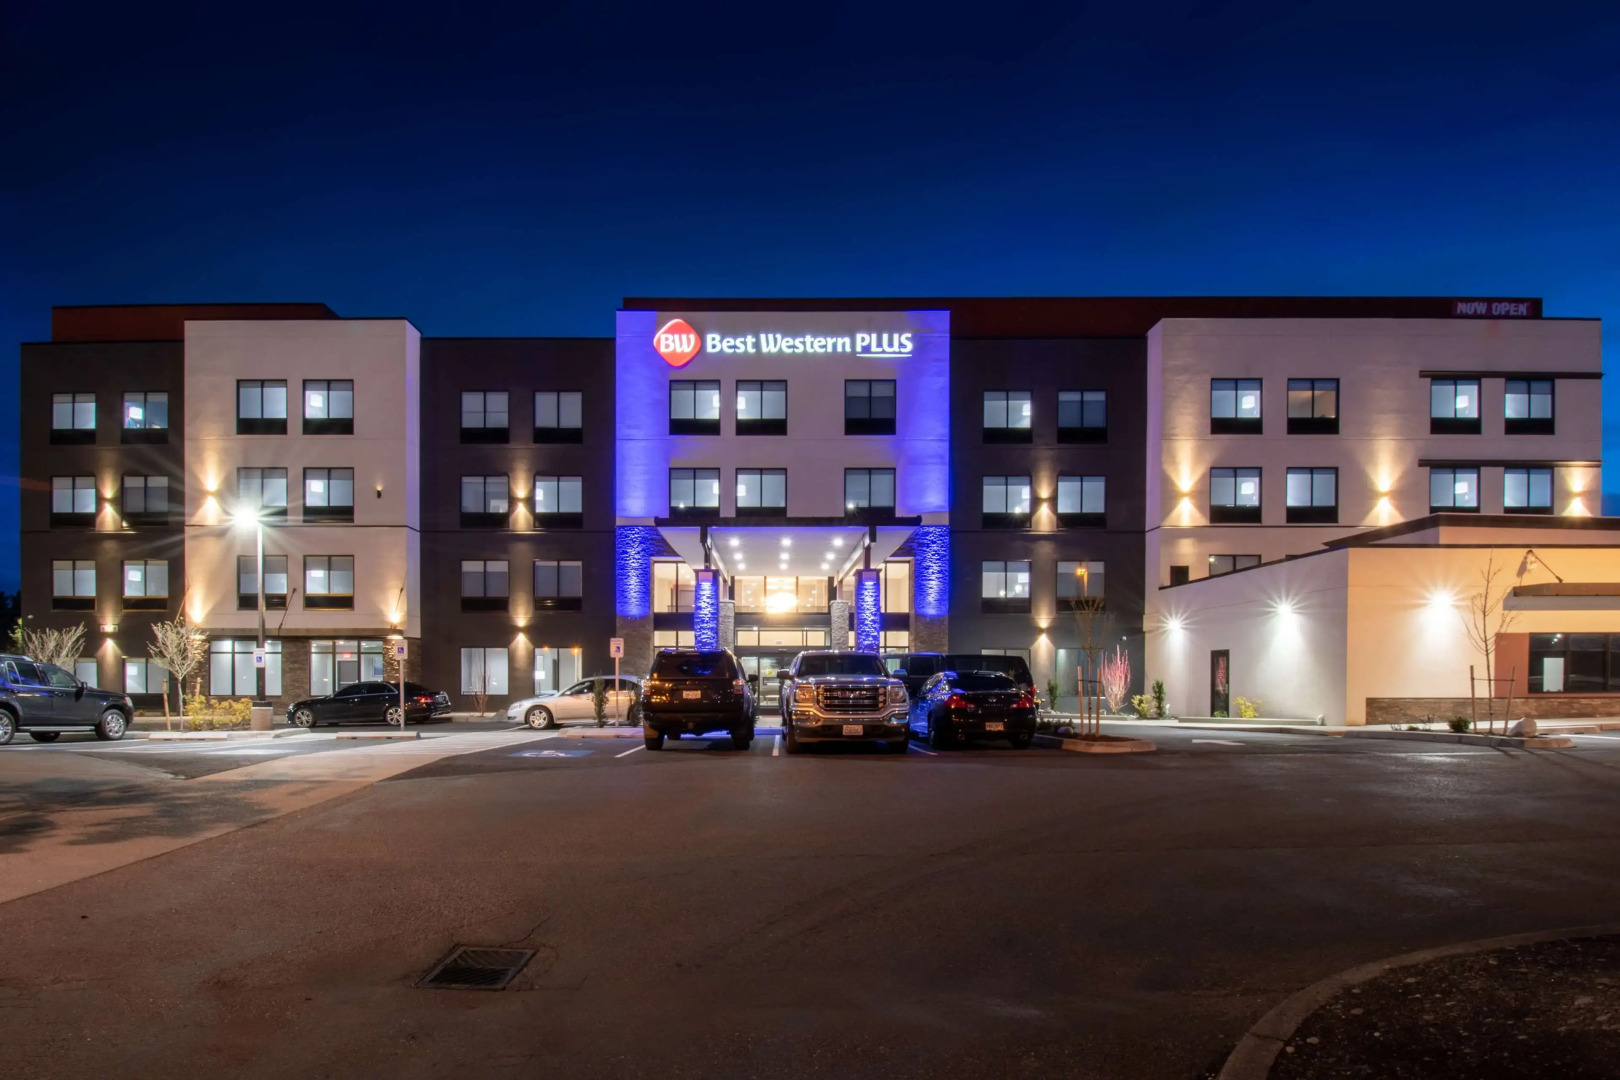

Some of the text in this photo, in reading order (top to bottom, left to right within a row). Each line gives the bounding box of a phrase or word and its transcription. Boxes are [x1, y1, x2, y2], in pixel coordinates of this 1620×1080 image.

[1457, 301, 1527, 315] NOW OPEN
[660, 333, 695, 352] BW
[706, 332, 913, 353] Best Western PLUS
